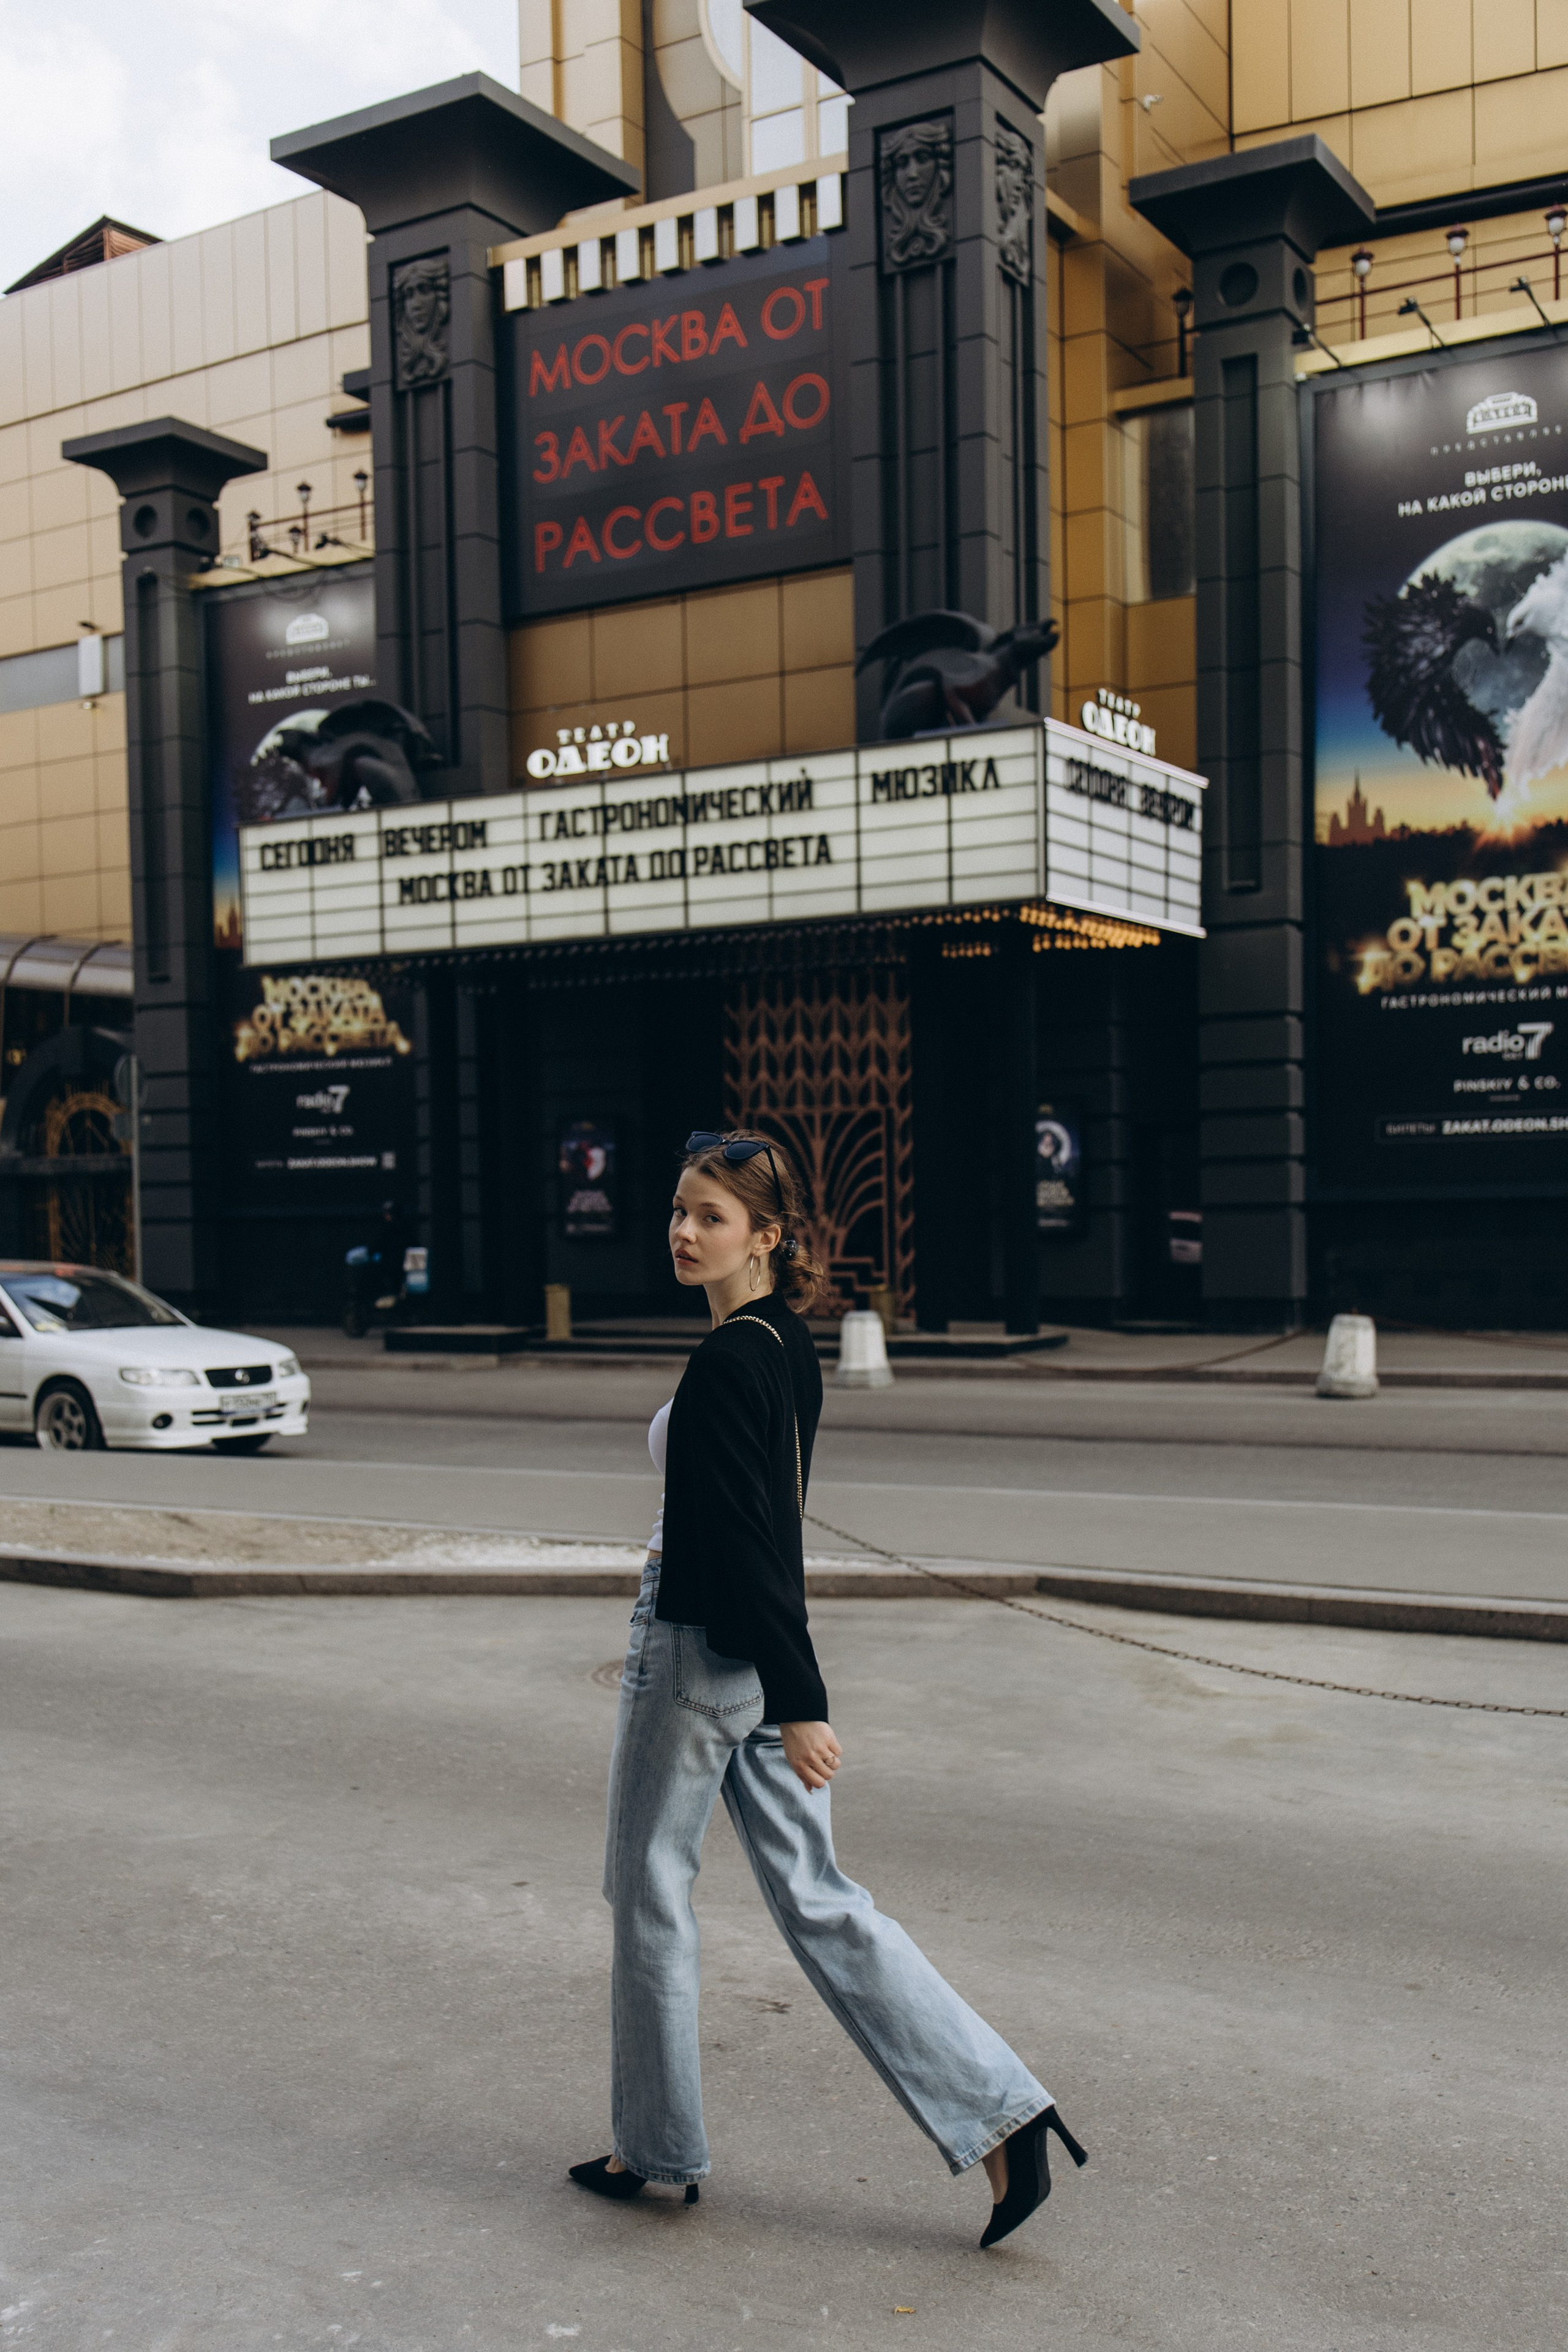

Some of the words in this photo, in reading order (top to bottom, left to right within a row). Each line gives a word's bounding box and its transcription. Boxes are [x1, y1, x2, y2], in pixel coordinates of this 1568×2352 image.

[528, 302, 748, 398] МОСКВА
[760, 277, 830, 341] ОТ
[532, 397, 729, 484] ЗАКАТА
[739, 372, 831, 445] ДО
[1397, 499, 1423, 518] НА
[1427, 486, 1487, 513] КАКОЙ
[1491, 474, 1568, 502] СТОРОН
[1464, 460, 1542, 488] ВЫБЕРИ,
[533, 470, 829, 573] РАССВЕТА
[556, 720, 636, 745] ТЕАТР
[527, 733, 669, 778] ОДЕОН
[260, 834, 355, 871] СЕГОДНЯ
[383, 820, 488, 858] ВЕЧЕРОМ
[540, 767, 814, 841] ГАСТРОНОМИЧЕСКИЙ
[872, 757, 1000, 804] МЮЗИКЛ
[398, 869, 492, 905] МОСКВА
[503, 863, 532, 894] ОТ
[541, 854, 639, 891] ЗАКАТА
[649, 849, 687, 880] ДО
[693, 834, 833, 876] РАССВЕТА
[1387, 916, 1447, 951] ОТ
[1381, 984, 1552, 1009] ГАСТРОНОМИЧЕСКИЙ
